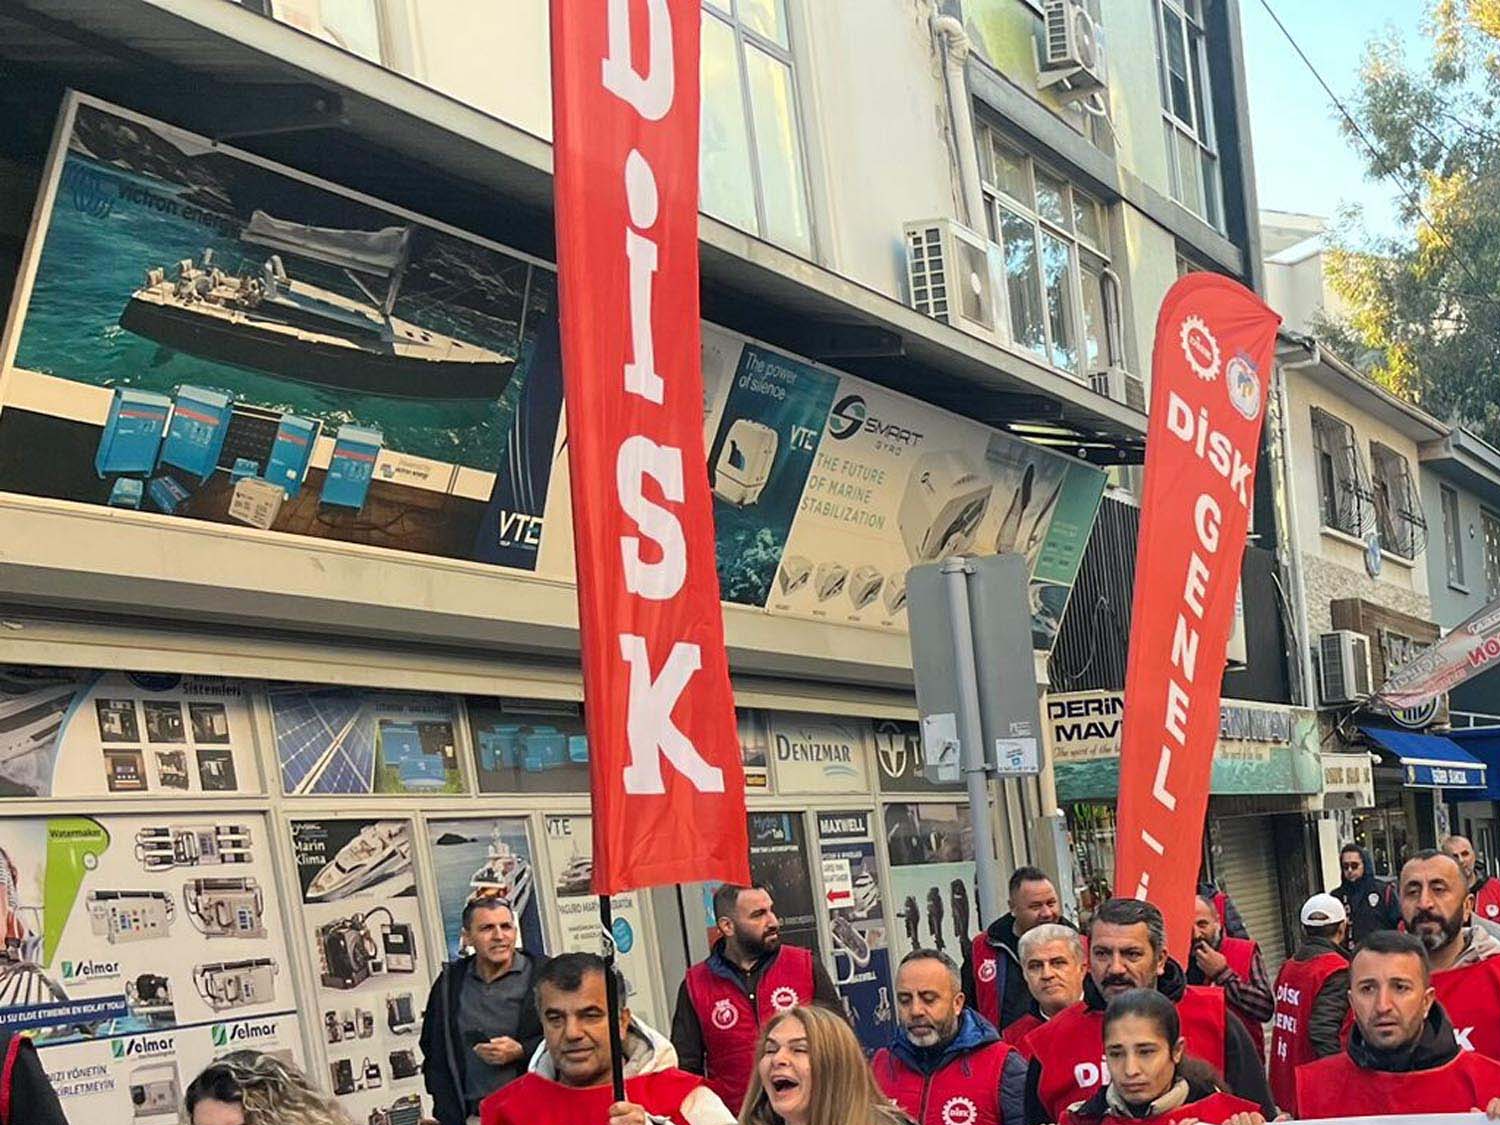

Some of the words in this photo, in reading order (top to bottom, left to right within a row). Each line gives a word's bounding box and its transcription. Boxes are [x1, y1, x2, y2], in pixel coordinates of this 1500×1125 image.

[746, 351, 764, 374] The
[765, 361, 799, 386] power
[739, 374, 751, 390] of
[750, 379, 787, 401] silence
[791, 424, 819, 451] VTE
[863, 418, 924, 447] SMART
[1167, 389, 1252, 508] DİSK
[842, 460, 887, 486] FUTURE
[808, 475, 826, 491] OF
[829, 479, 873, 505] MARINE
[500, 510, 545, 545] VTE
[801, 497, 886, 530] STABILIZATION
[1151, 492, 1223, 813] GENEL
[1055, 720, 1123, 742] MAV
[777, 734, 853, 764] DENİZMAR
[50, 828, 102, 841] Watermaker
[820, 819, 866, 834] MAXWELL
[1073, 1056, 1111, 1088] Dİ
